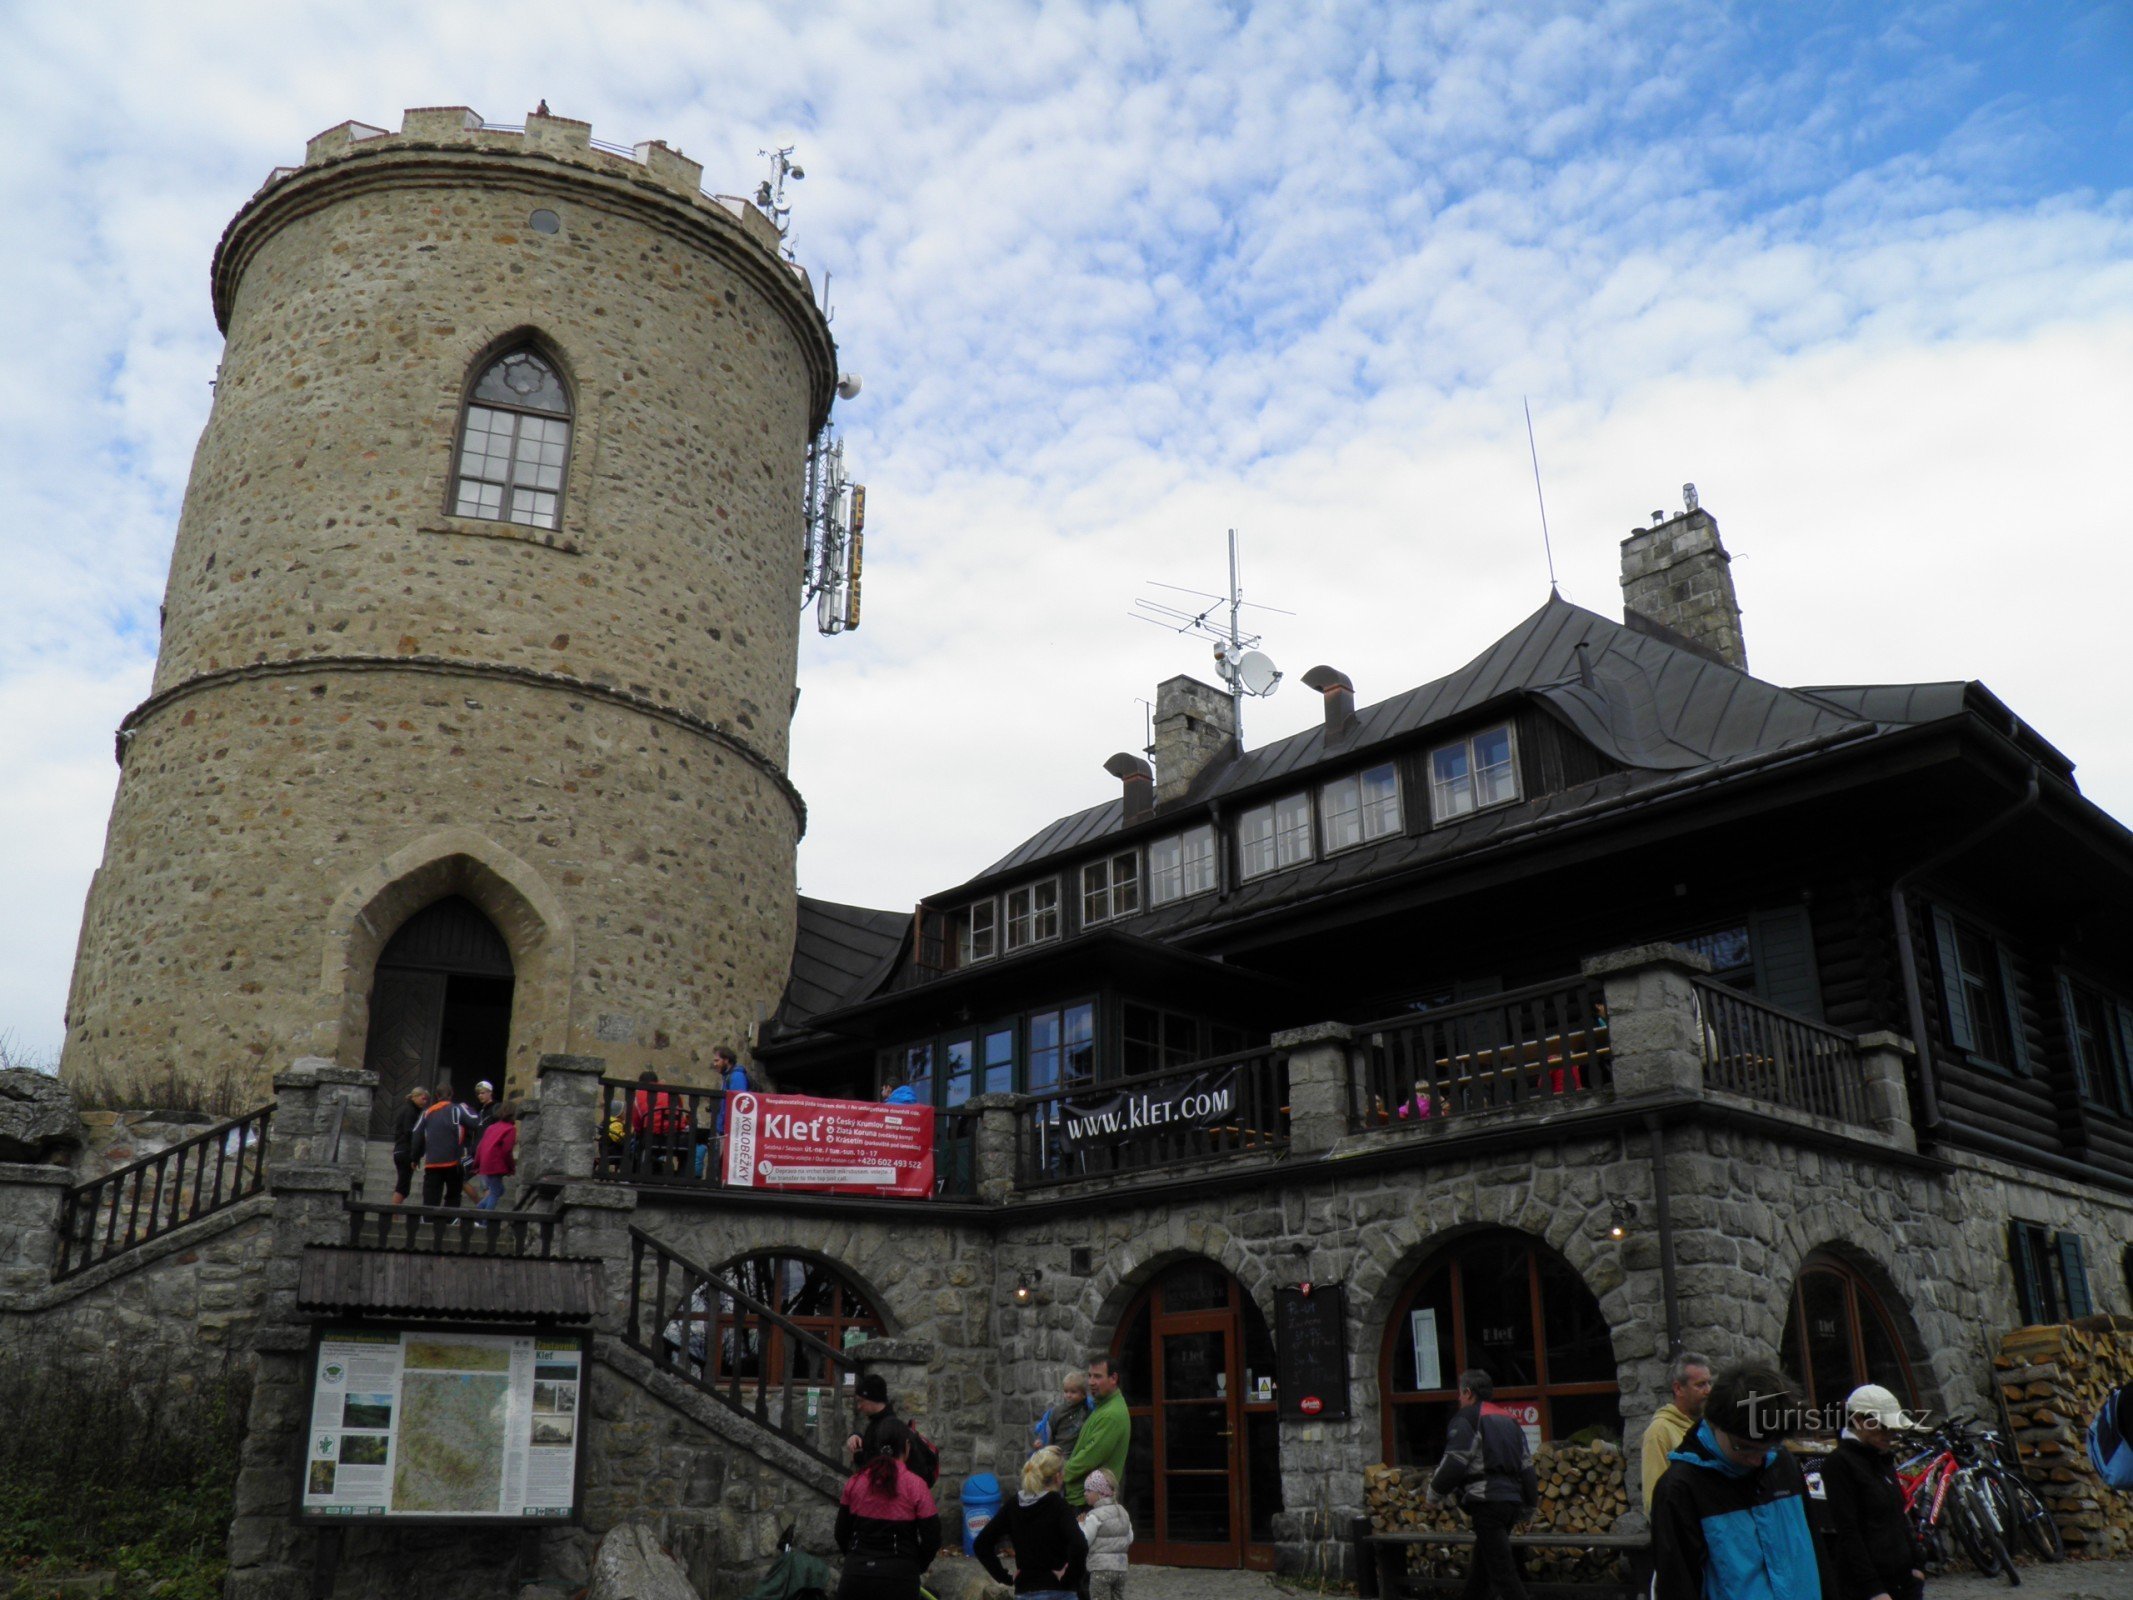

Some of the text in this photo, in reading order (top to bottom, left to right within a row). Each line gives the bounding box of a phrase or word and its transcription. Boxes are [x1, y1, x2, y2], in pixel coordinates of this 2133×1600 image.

[764, 1113, 824, 1141] Kleť
[836, 1115, 884, 1129] Český Krumlov
[853, 1129, 877, 1138] Koruna
[738, 1116, 752, 1182] KOLOBĚŽKY
[857, 1149, 865, 1157] 10
[858, 1157, 876, 1165] +420
[877, 1159, 892, 1167] 602
[893, 1160, 907, 1168] 493
[908, 1161, 922, 1169] 522
